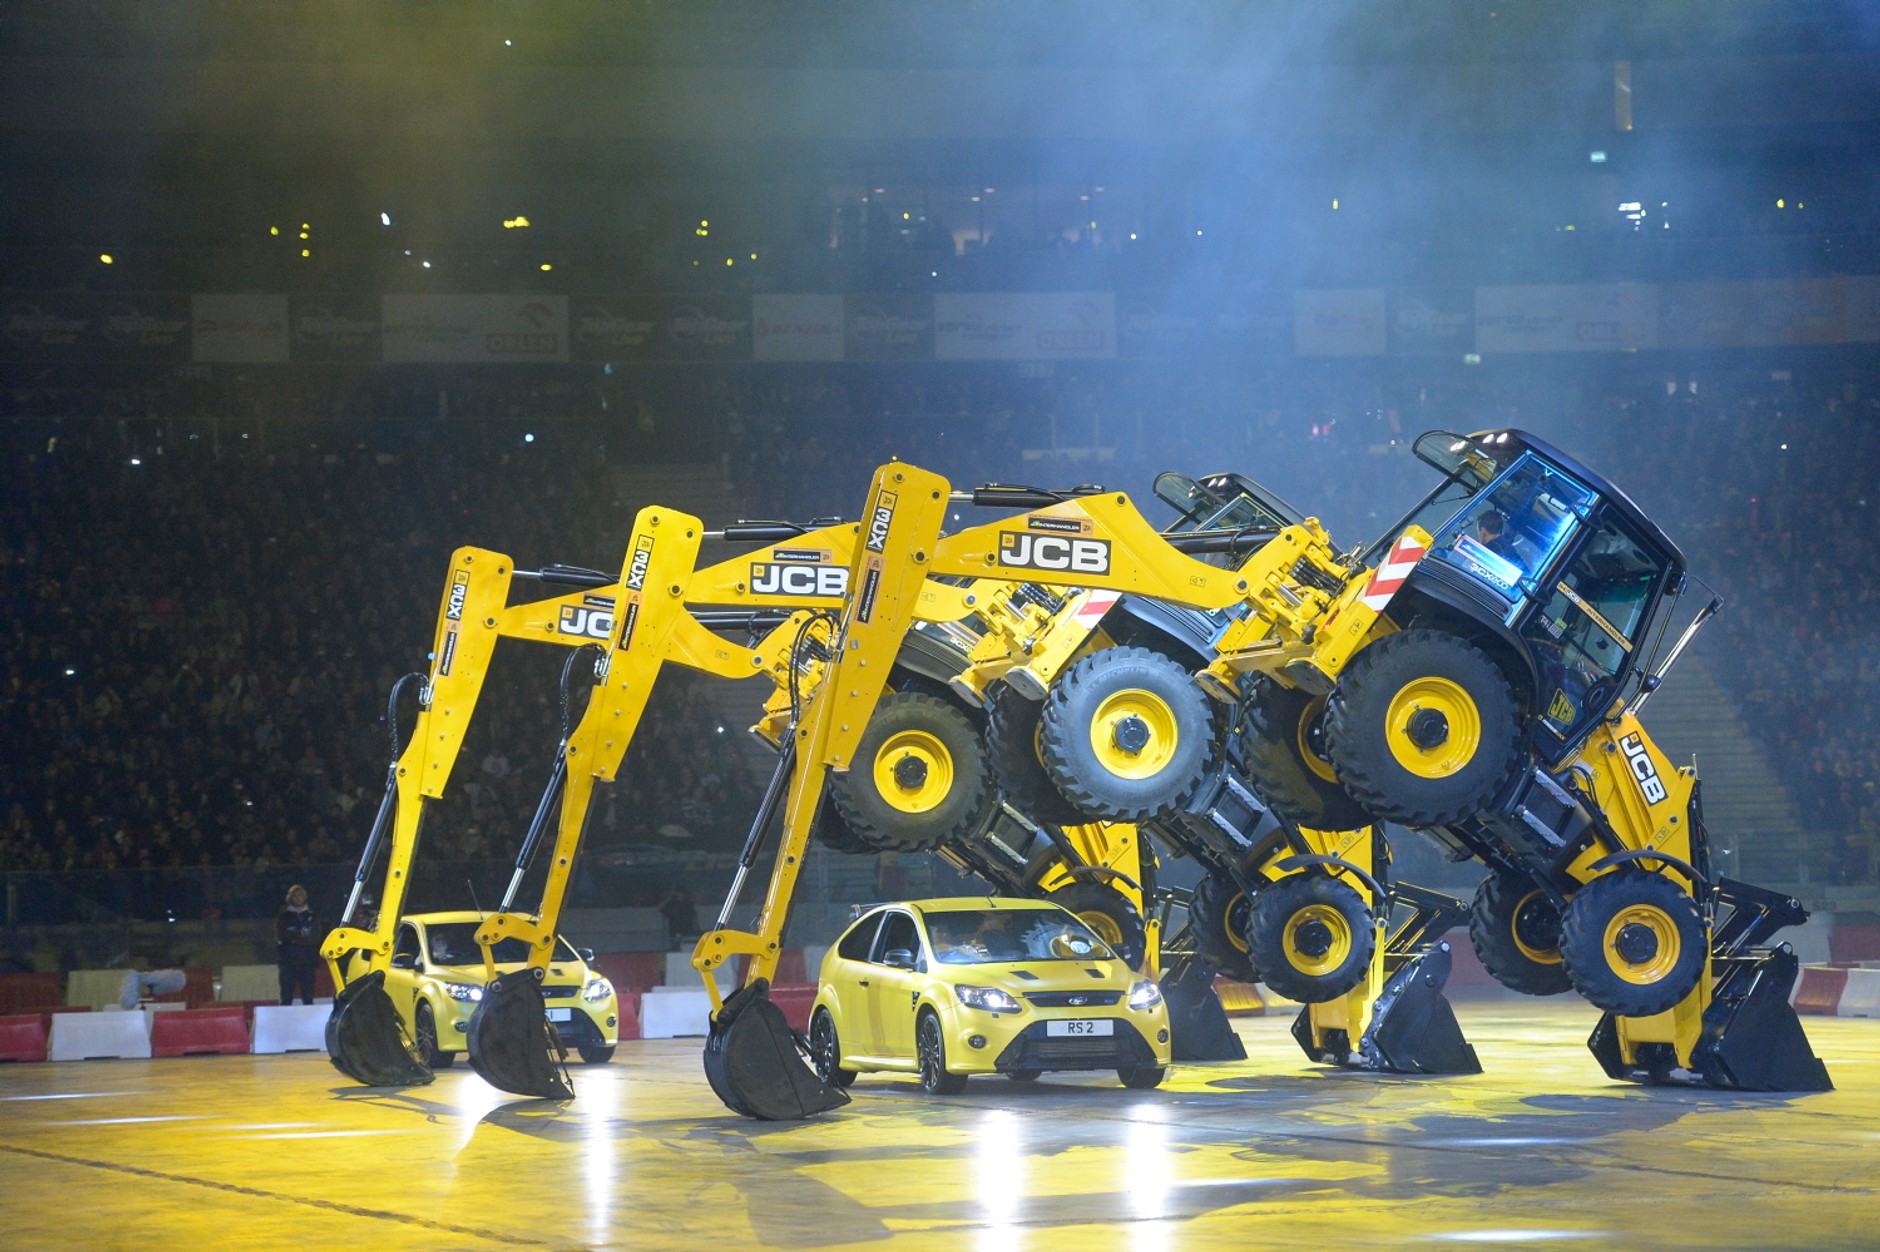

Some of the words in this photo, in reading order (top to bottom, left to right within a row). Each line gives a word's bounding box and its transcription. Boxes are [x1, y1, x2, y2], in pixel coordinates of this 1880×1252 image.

[490, 335, 555, 350] ORLEN
[868, 508, 891, 549] 3CX
[628, 550, 649, 588] 3CX
[1001, 535, 1108, 572] JCB
[752, 565, 850, 595] JCB
[447, 584, 466, 618] 3CX
[560, 609, 614, 638] JC
[1586, 607, 1626, 645] INTERHANDLER
[1550, 694, 1574, 723] JCB
[1621, 737, 1665, 804] JCB
[1067, 1022, 1083, 1033] RS
[1086, 1022, 1094, 1033] 2
